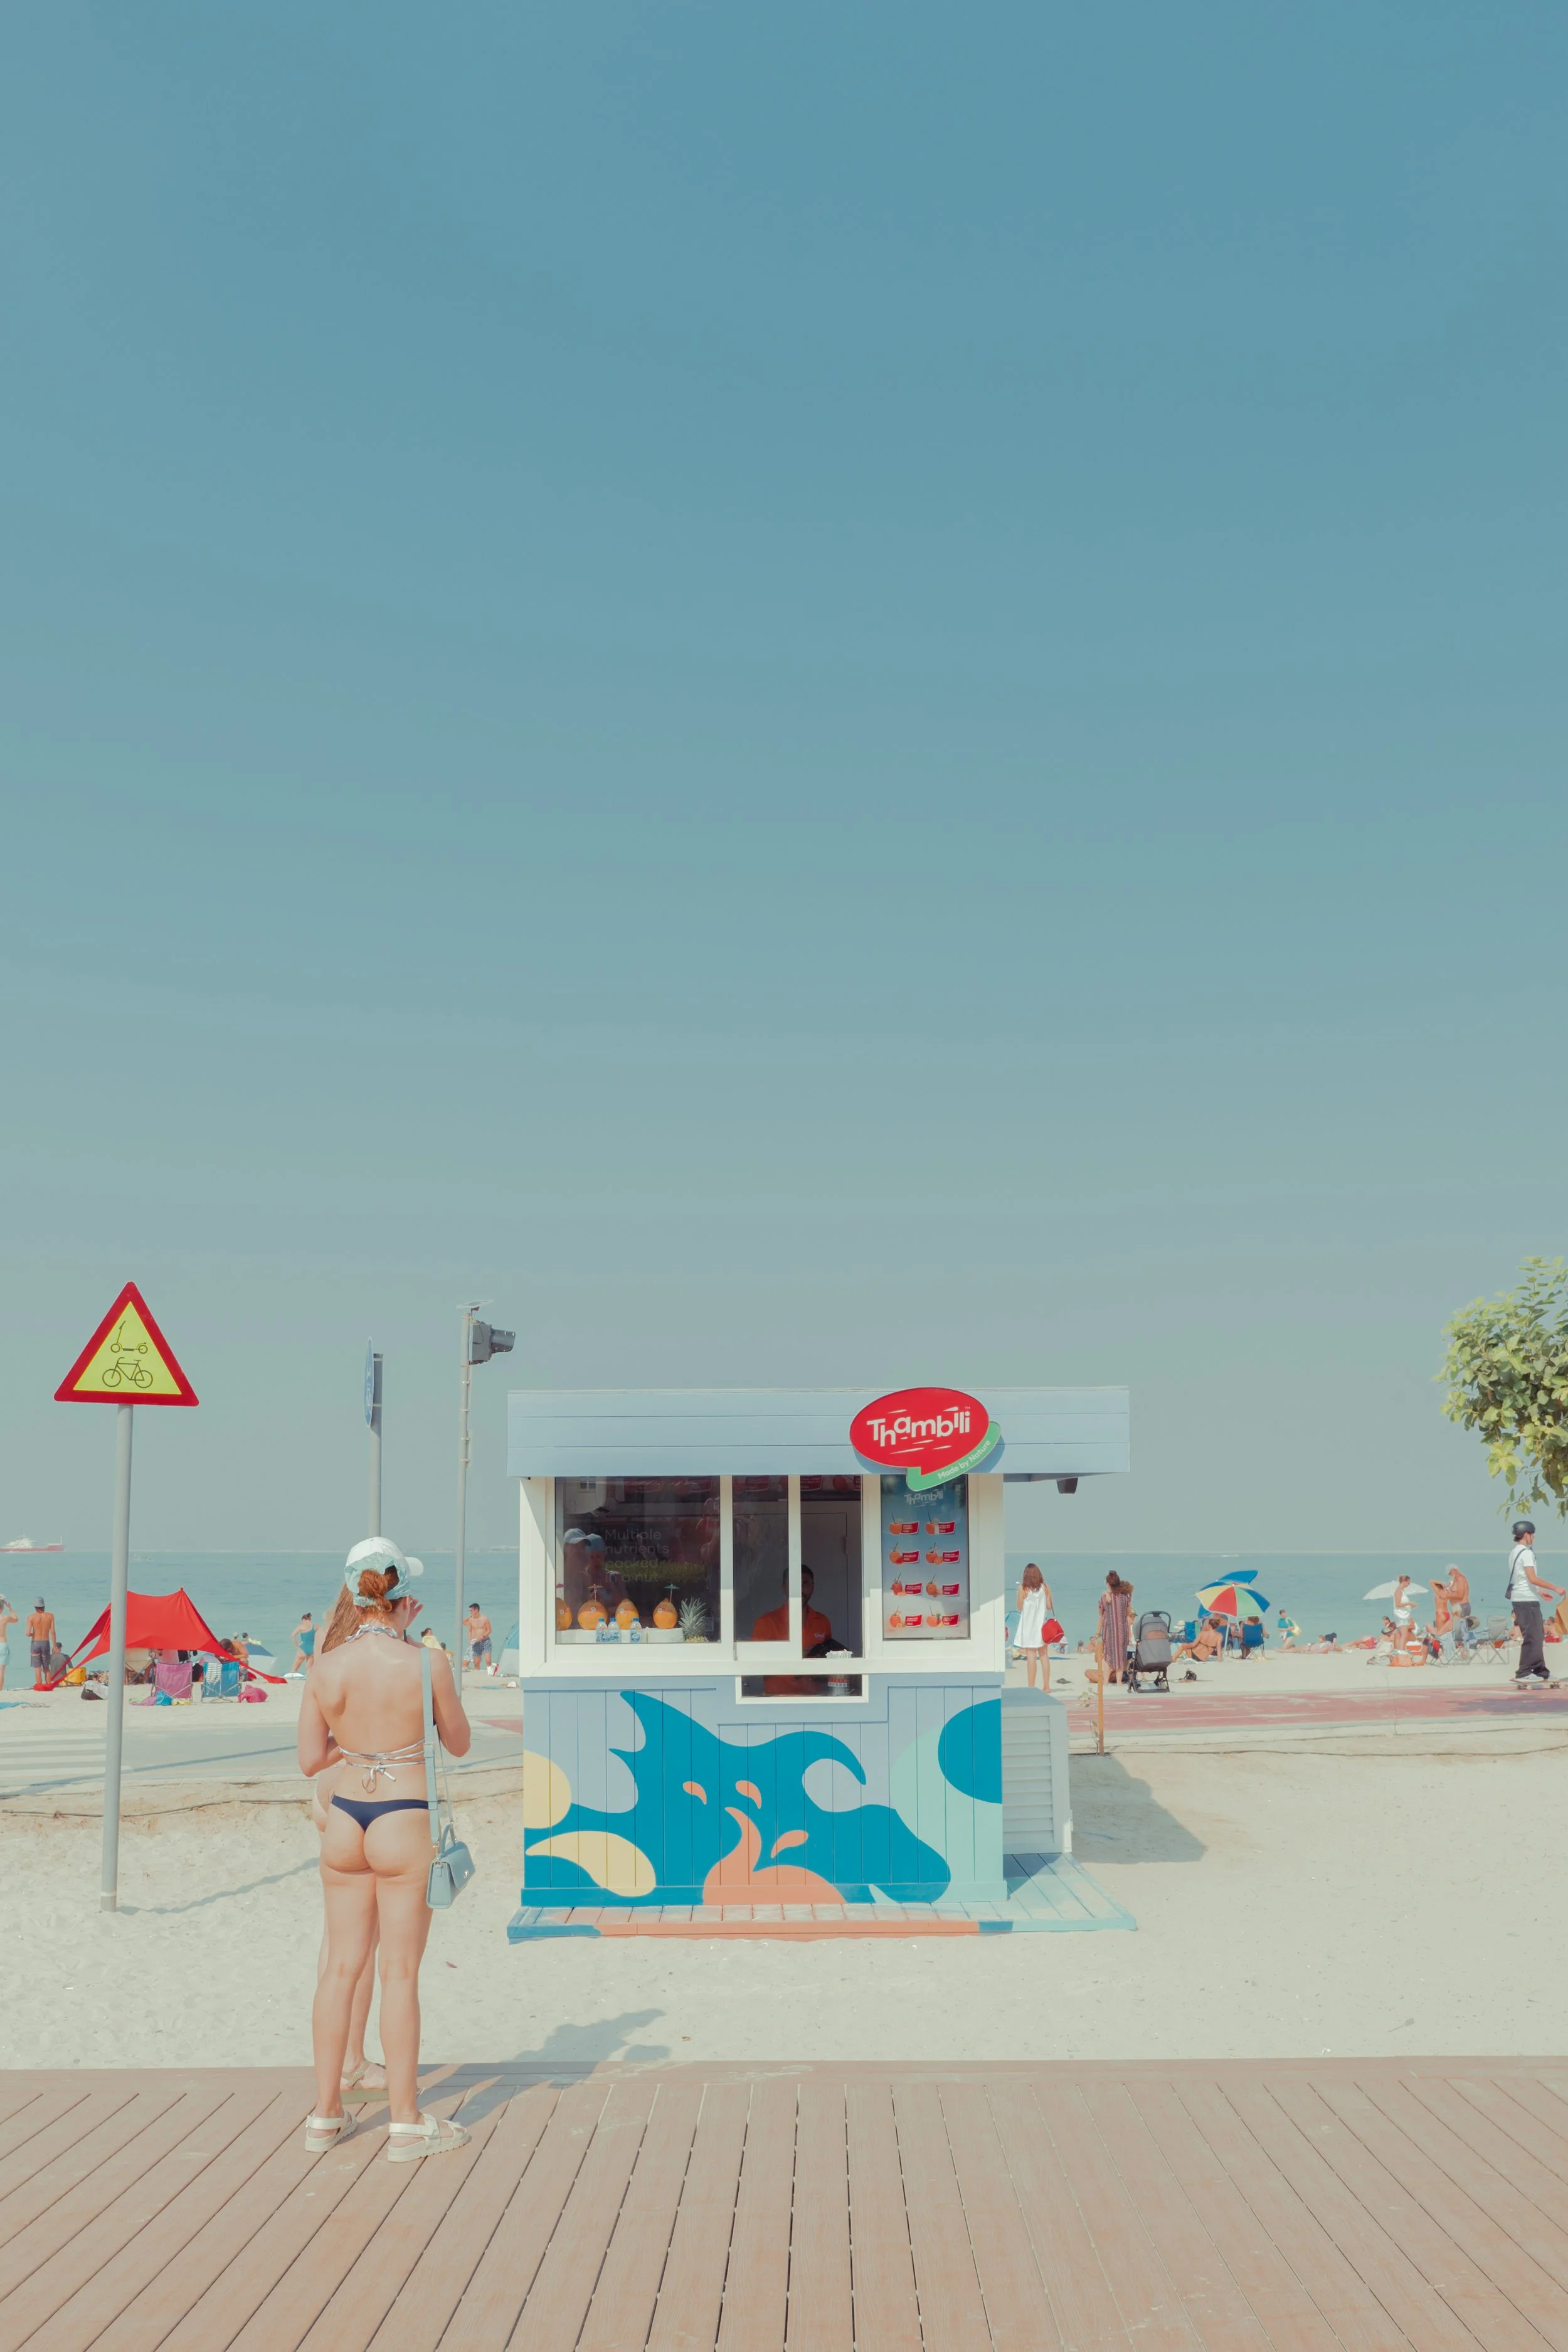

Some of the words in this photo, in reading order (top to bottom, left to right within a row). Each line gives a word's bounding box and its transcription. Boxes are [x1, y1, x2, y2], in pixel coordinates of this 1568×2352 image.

[867, 1406, 970, 1447] Thambili
[938, 1466, 959, 1479] Made
[958, 1460, 969, 1468] by
[968, 1440, 991, 1462] Nature
[904, 1489, 943, 1505] Thambili
[605, 1528, 662, 1542] Multiple
[605, 1543, 669, 1554] nutrients
[605, 1557, 659, 1570] packed
